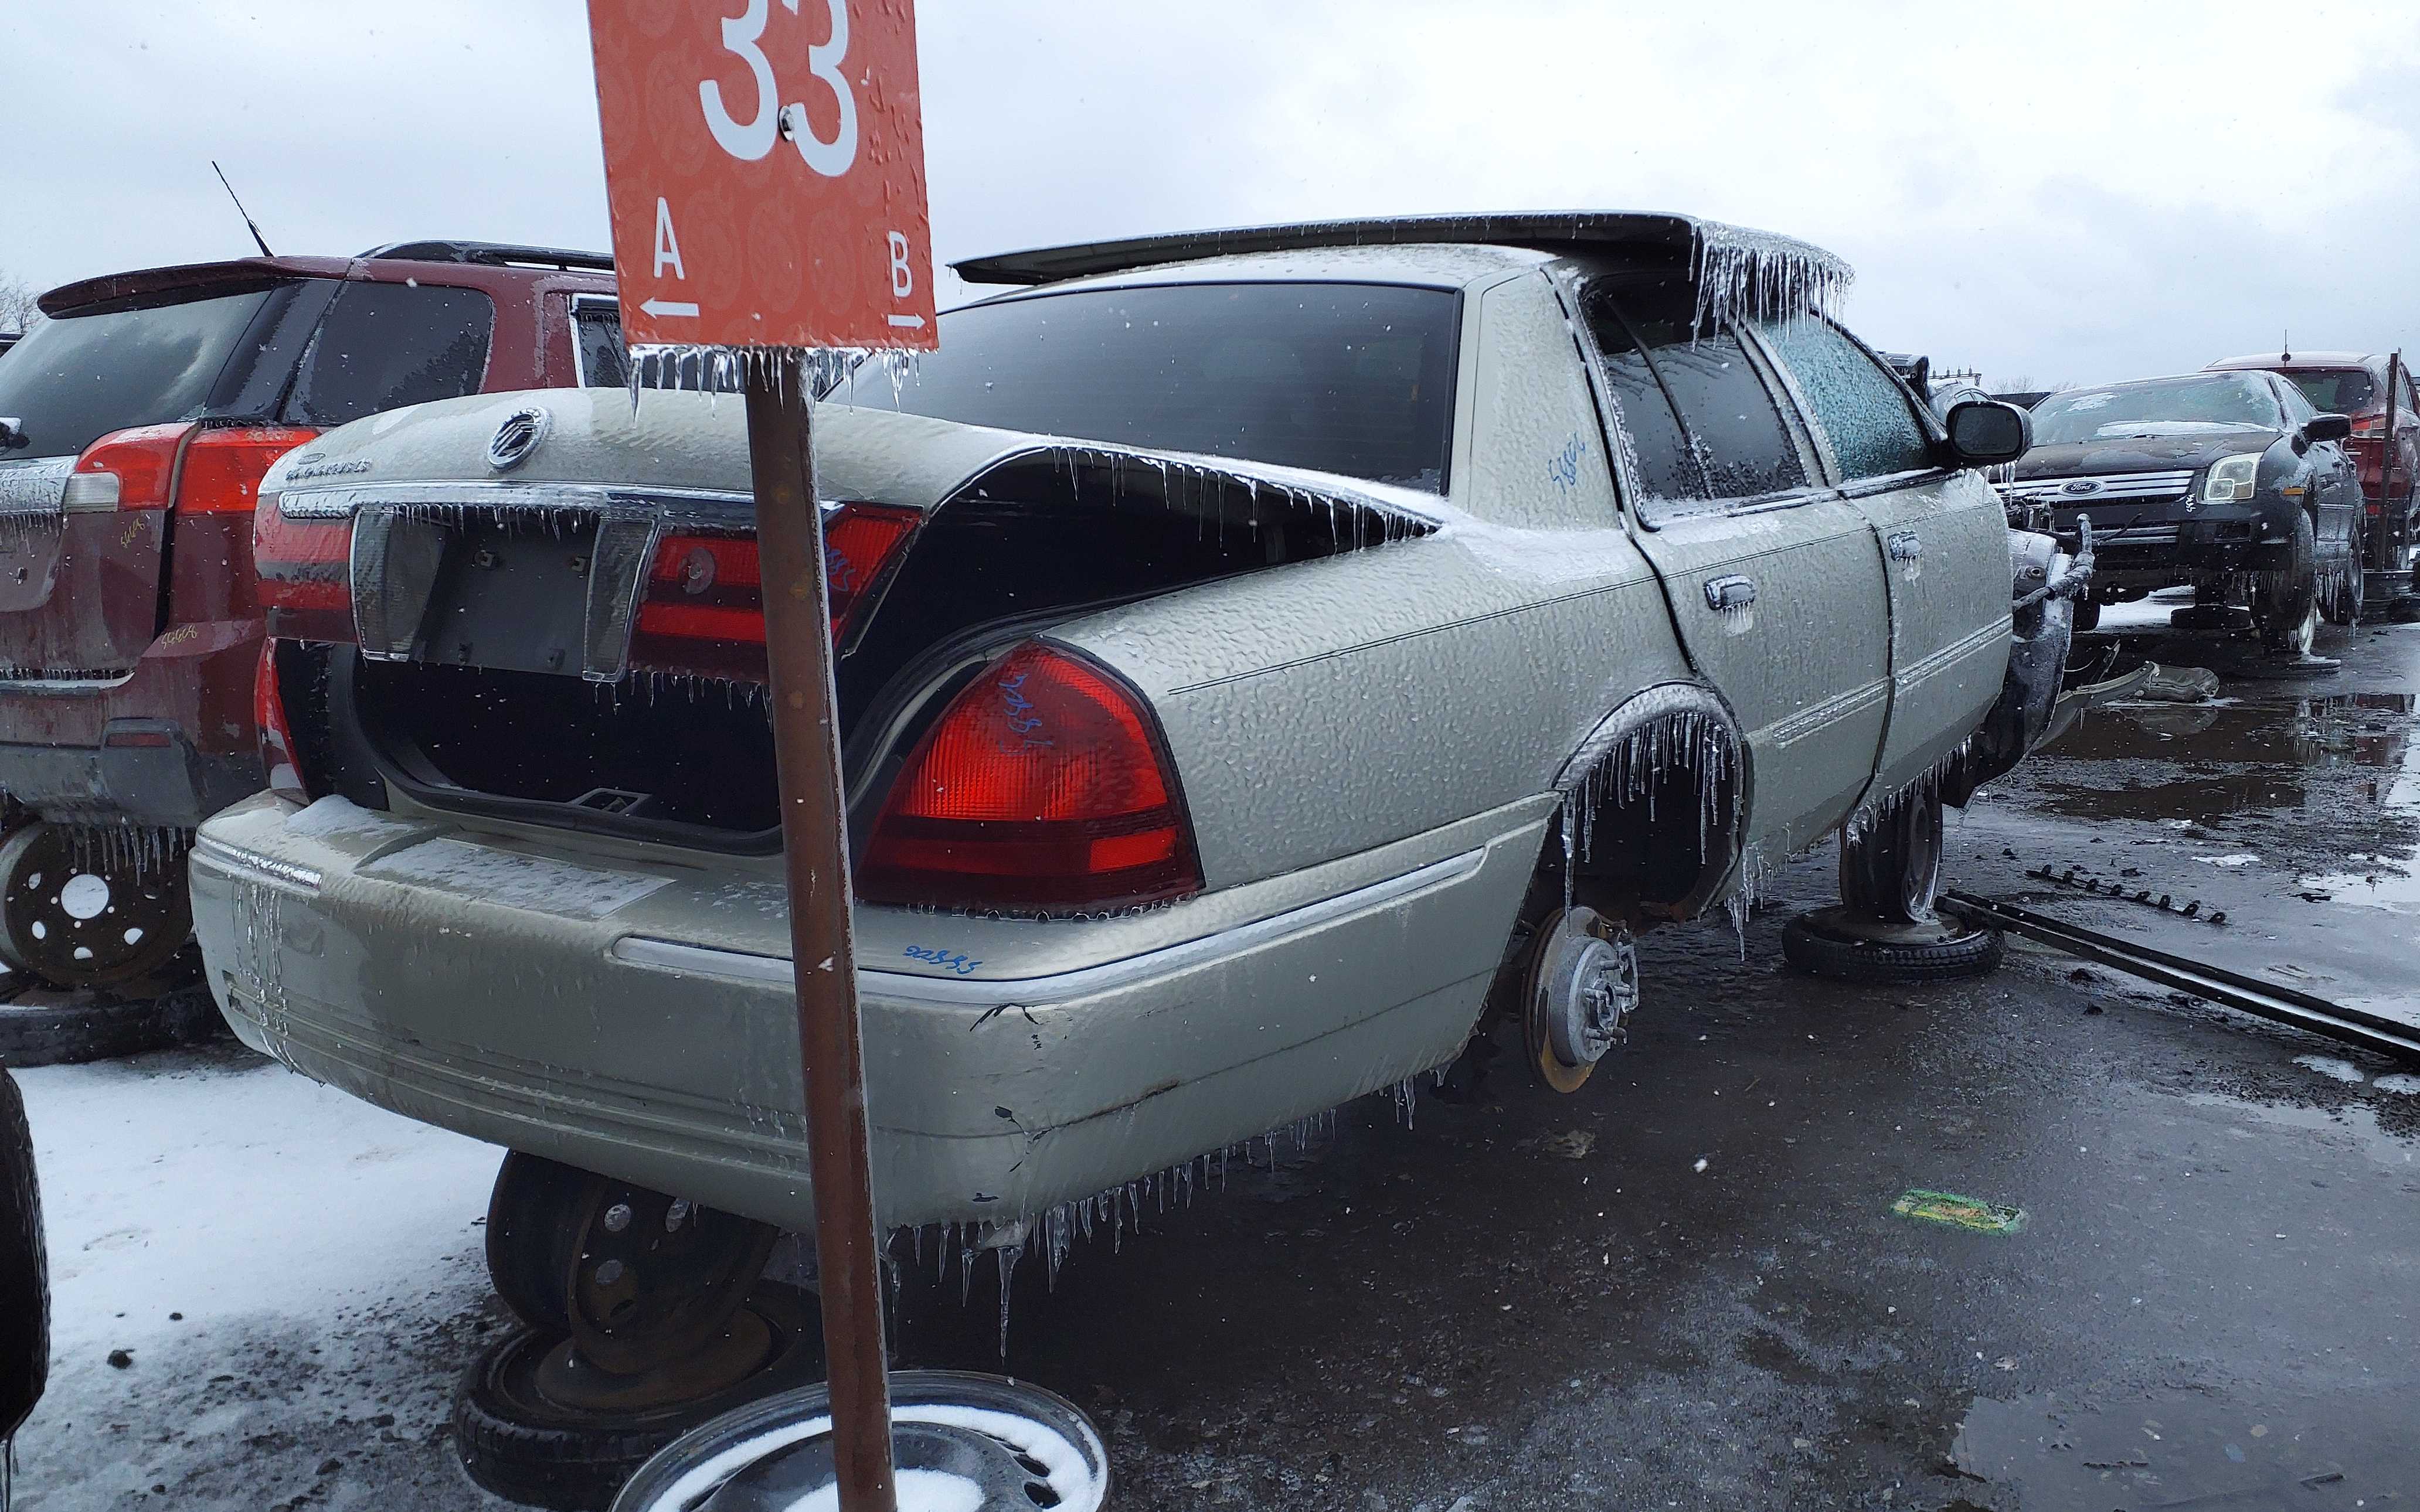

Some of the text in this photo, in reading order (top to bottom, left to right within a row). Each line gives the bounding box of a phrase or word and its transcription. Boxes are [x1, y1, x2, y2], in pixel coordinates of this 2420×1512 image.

[699, 0, 858, 177] 33
[654, 197, 685, 280] A
[888, 231, 913, 297] B
